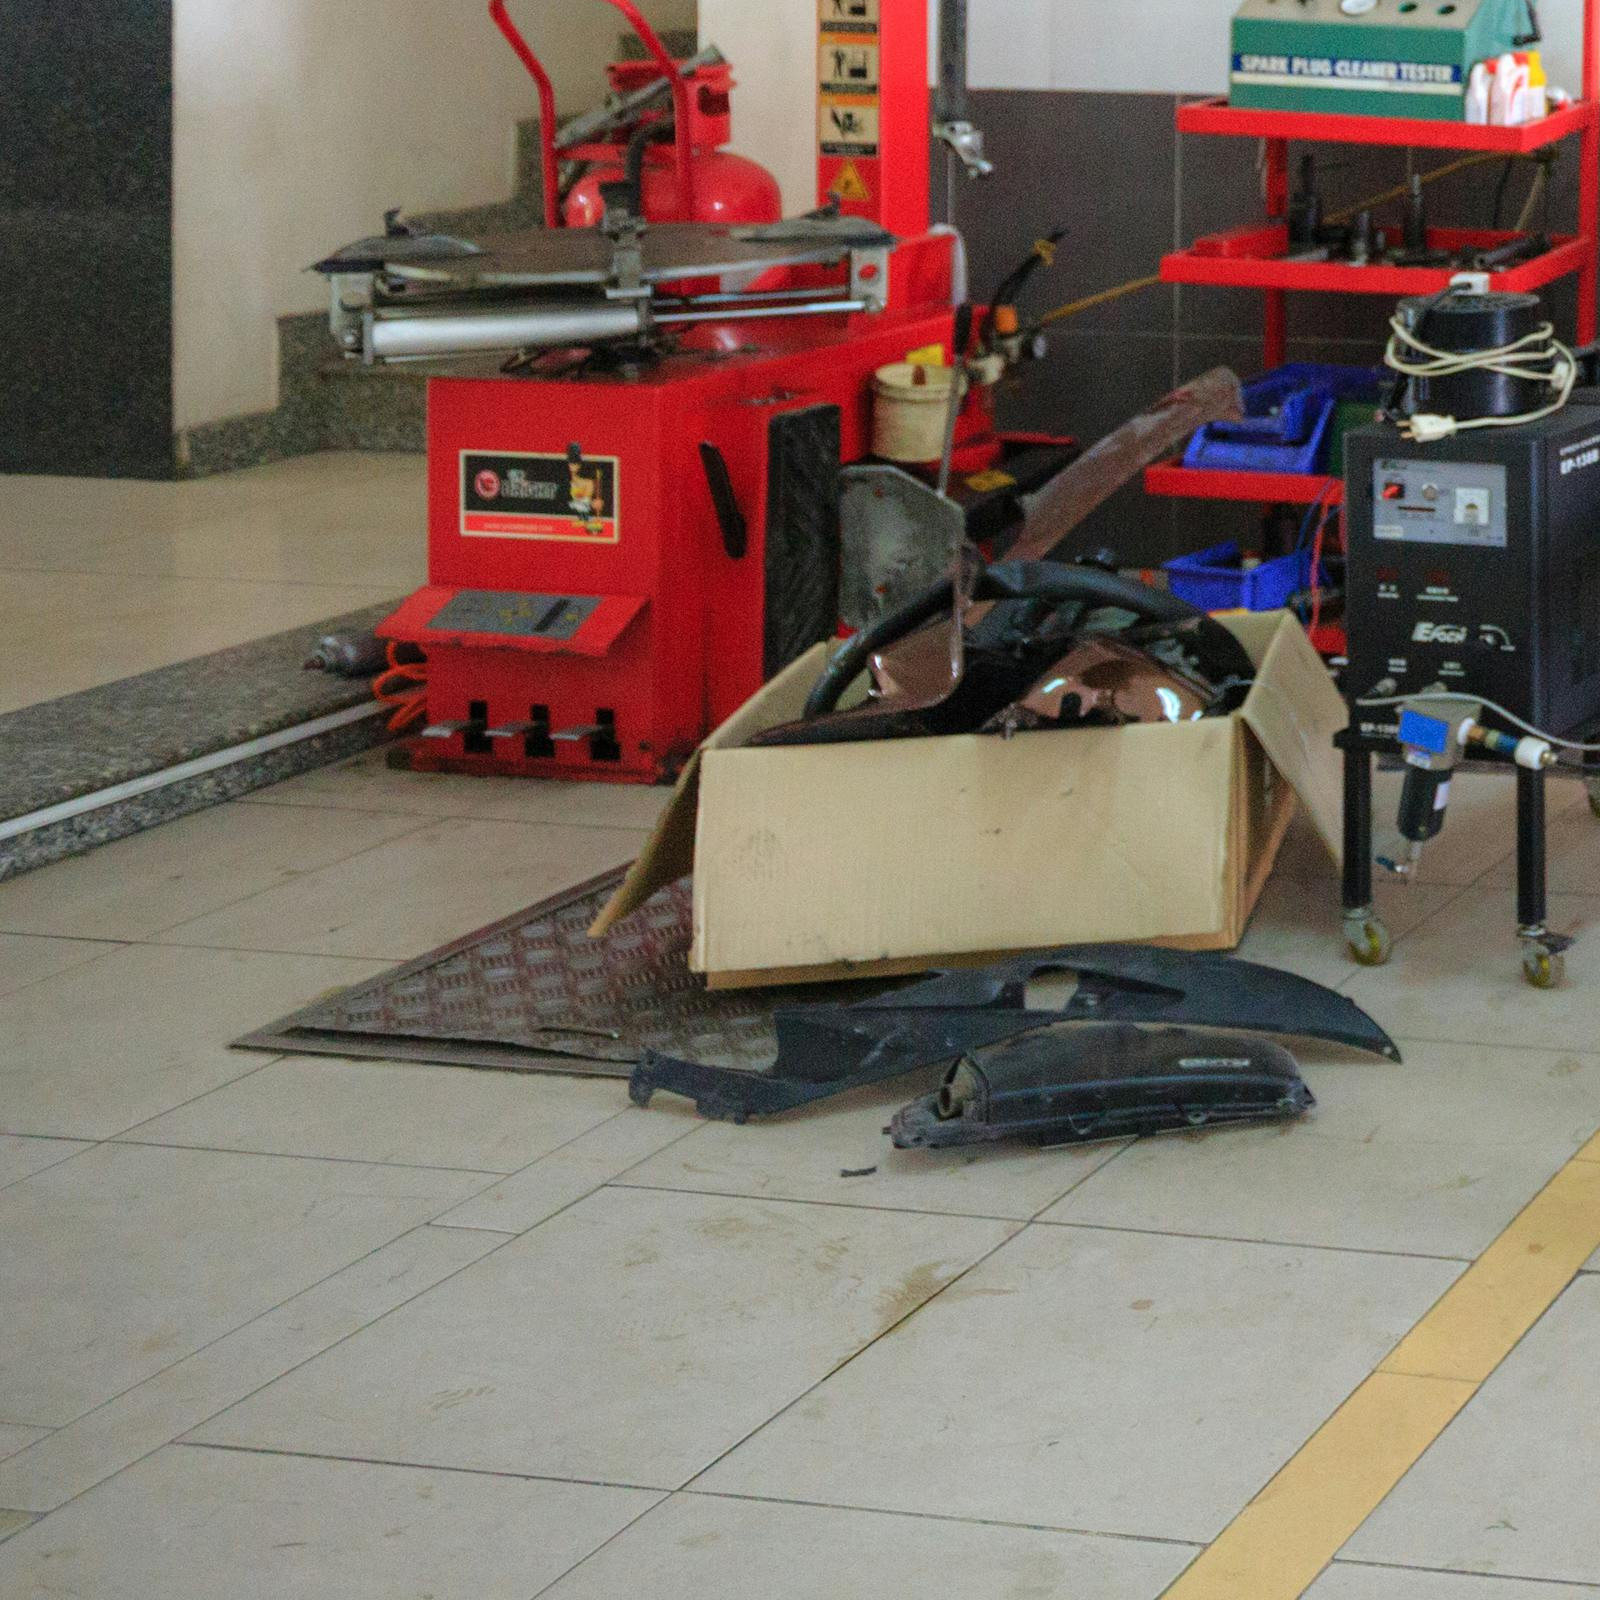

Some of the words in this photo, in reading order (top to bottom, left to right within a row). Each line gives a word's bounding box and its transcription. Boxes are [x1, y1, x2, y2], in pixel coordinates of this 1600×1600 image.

[1240, 54, 1288, 74] SPARK
[1292, 57, 1332, 77] PLUG
[1335, 59, 1398, 80] CLEANER
[1400, 62, 1454, 84] TESTER
